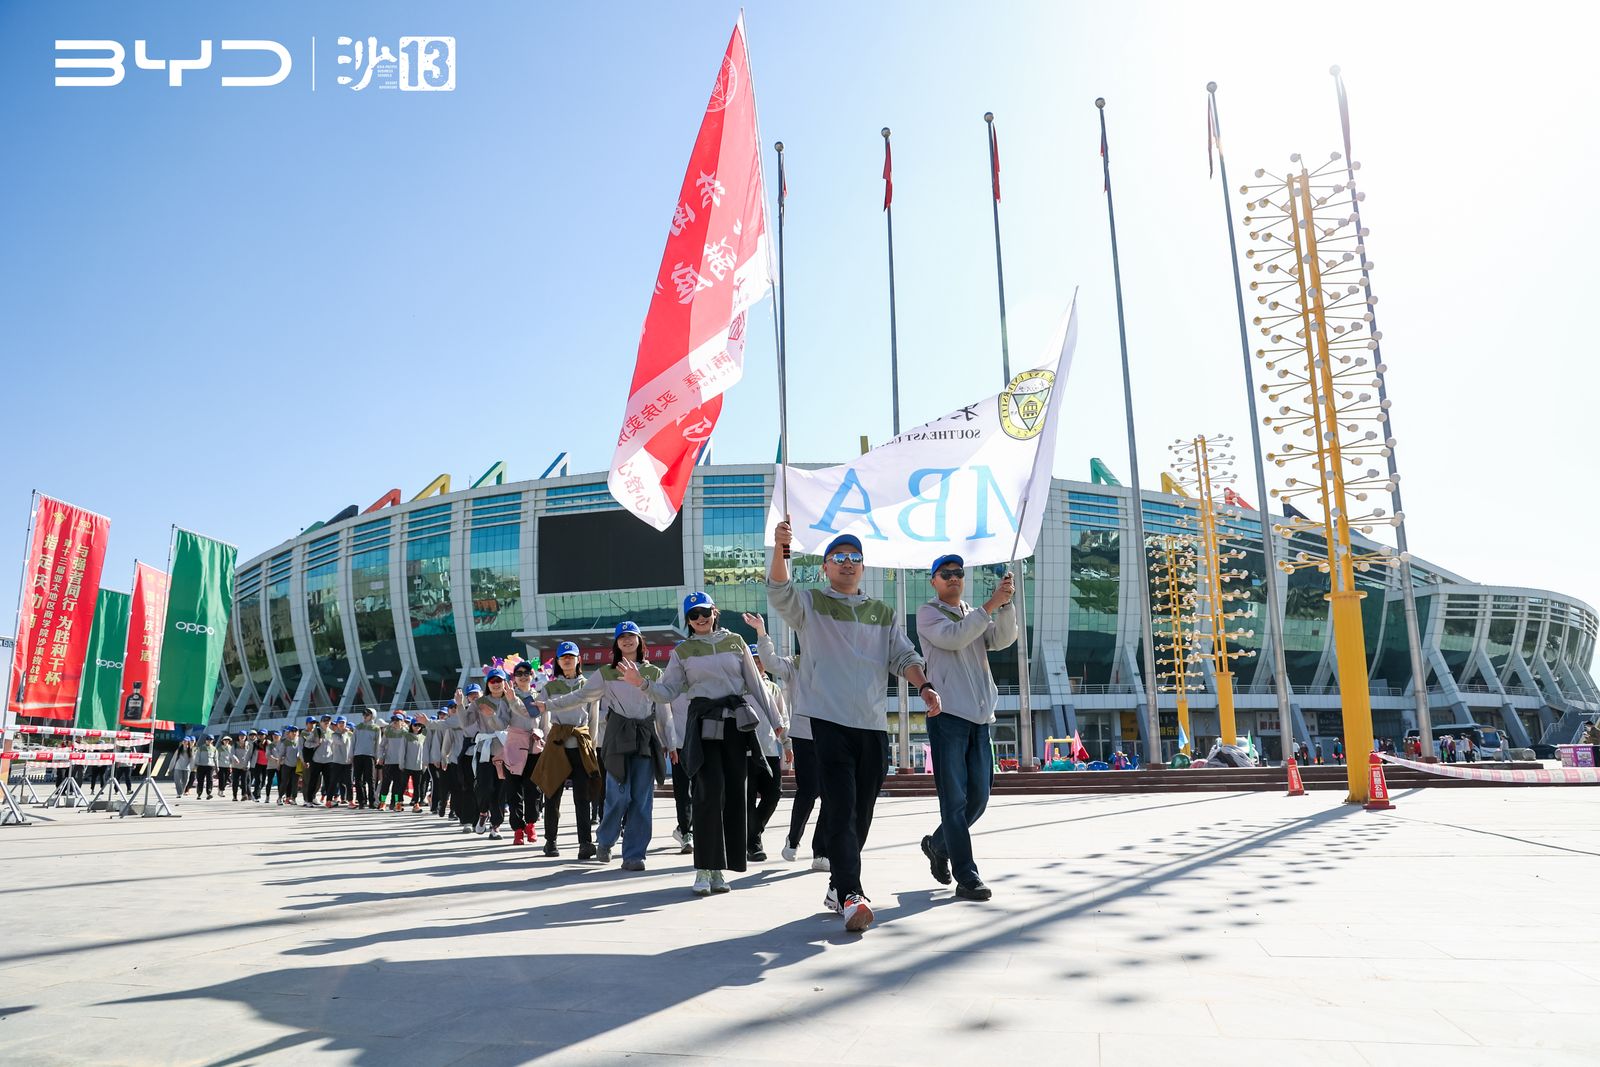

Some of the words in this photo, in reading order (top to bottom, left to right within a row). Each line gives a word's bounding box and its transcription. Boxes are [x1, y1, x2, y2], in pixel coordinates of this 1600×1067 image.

[44, 614, 73, 687] 为胜利干杯
